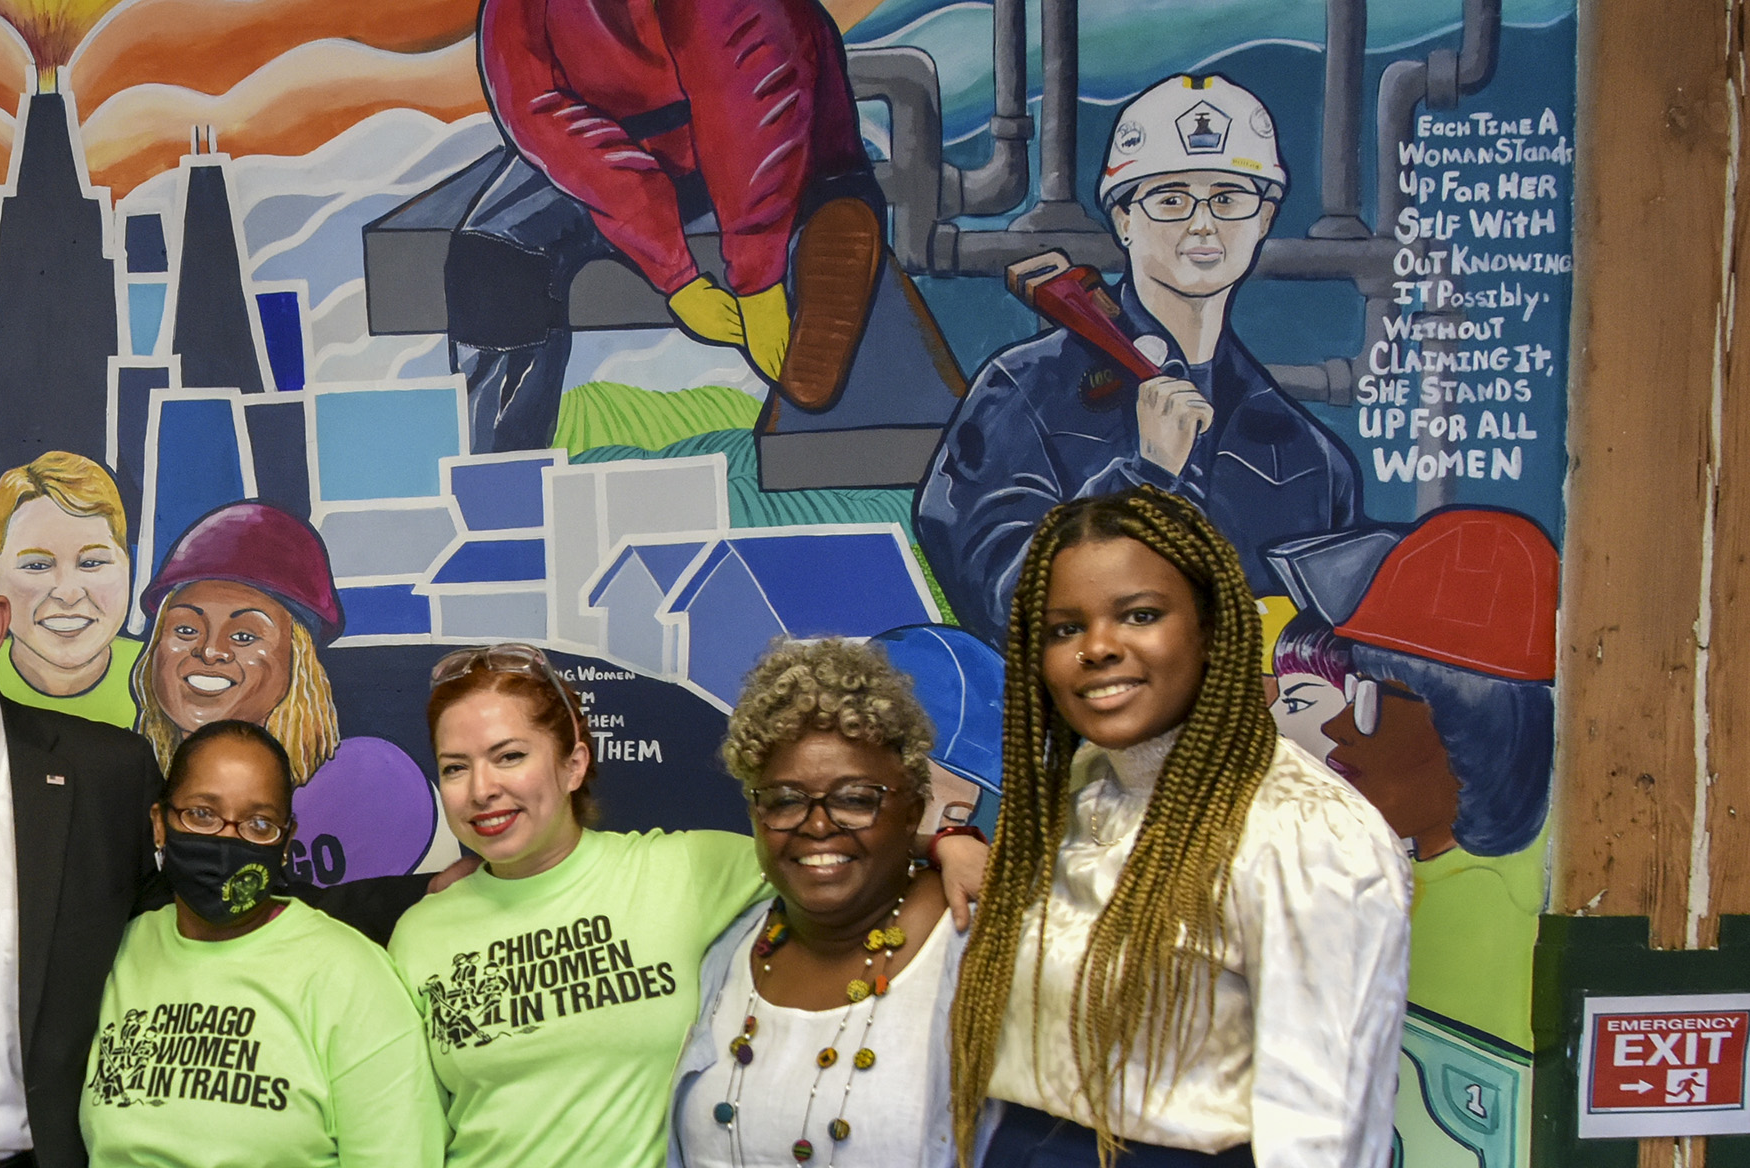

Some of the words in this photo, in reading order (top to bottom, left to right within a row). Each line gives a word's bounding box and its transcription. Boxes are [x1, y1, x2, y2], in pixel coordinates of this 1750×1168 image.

[1538, 107, 1558, 135] A
[1393, 281, 1433, 305] IT
[1356, 374, 1410, 406] SHE
[1420, 376, 1532, 404] STANDS
[1358, 407, 1405, 439] UP
[1477, 410, 1537, 440] ALL
[1373, 446, 1522, 482] WOMEN
[590, 731, 662, 763] THEM
[488, 914, 613, 968] CHICAGO
[505, 939, 634, 996] WOMEN
[509, 992, 545, 1028] IN
[550, 962, 676, 1018] TRADES
[151, 1002, 256, 1038] CHICAGO
[1607, 1017, 1740, 1032] EMERGENCY
[156, 1035, 261, 1072] WOMEN
[1613, 1031, 1732, 1067] EXIT
[146, 1066, 178, 1098] IN
[178, 1068, 290, 1111] TRADES
